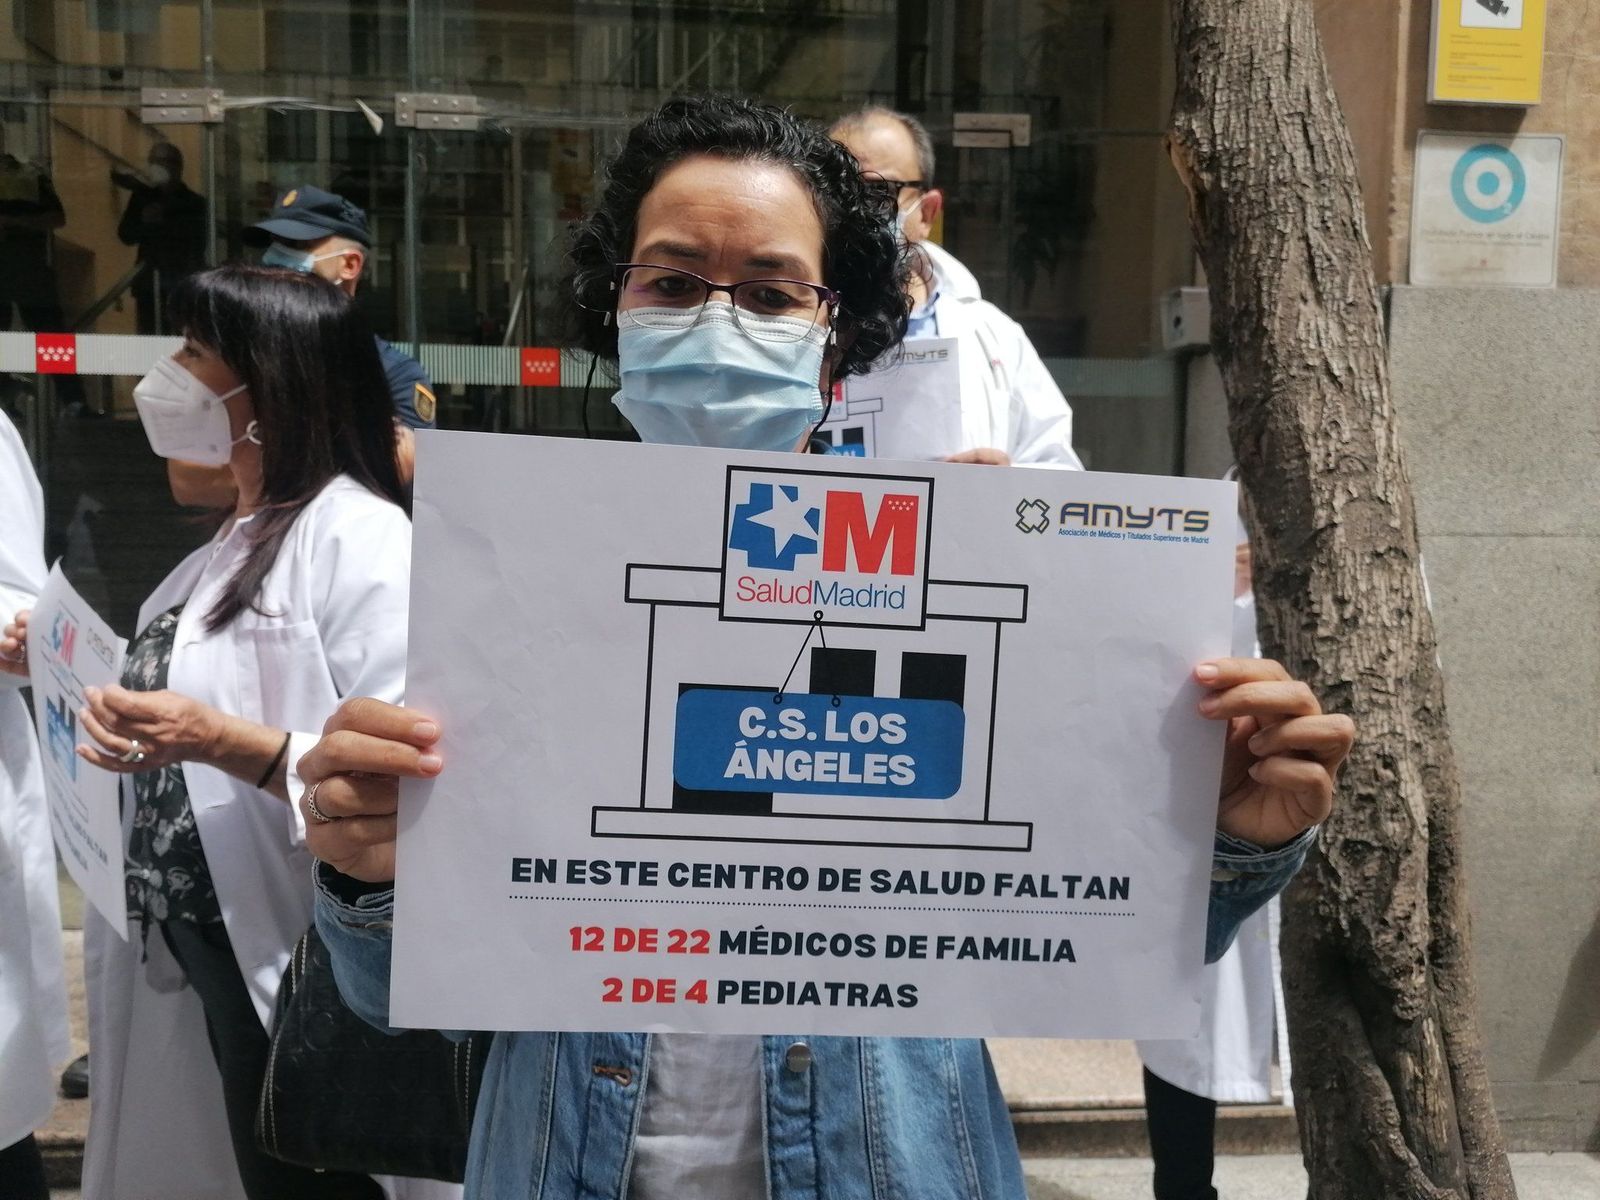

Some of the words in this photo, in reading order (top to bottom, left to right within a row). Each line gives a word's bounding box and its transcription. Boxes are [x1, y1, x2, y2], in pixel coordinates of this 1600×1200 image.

[822, 490, 919, 575] M
[1058, 528, 1089, 537] Asociación
[1060, 502, 1209, 532] AMYTS
[738, 706, 818, 741] C.S.
[825, 710, 907, 745] LOS
[723, 739, 916, 786] ÁNGELES
[511, 857, 557, 884] EN
[566, 859, 659, 887] ESTE
[667, 862, 809, 891] CENTRO
[817, 867, 861, 892] DE
[870, 868, 986, 895] SALUD
[994, 873, 1130, 900] FALTAN
[569, 926, 605, 951] 12
[613, 927, 658, 952] DE
[667, 928, 711, 954] 22
[719, 924, 876, 957] MÉDICOS
[885, 935, 928, 959] DE
[936, 935, 1077, 962] FAMILIA
[602, 977, 623, 1003] 2
[632, 978, 676, 1003] DE
[685, 979, 708, 1004] 4
[717, 980, 918, 1007] PEDIATRAS
